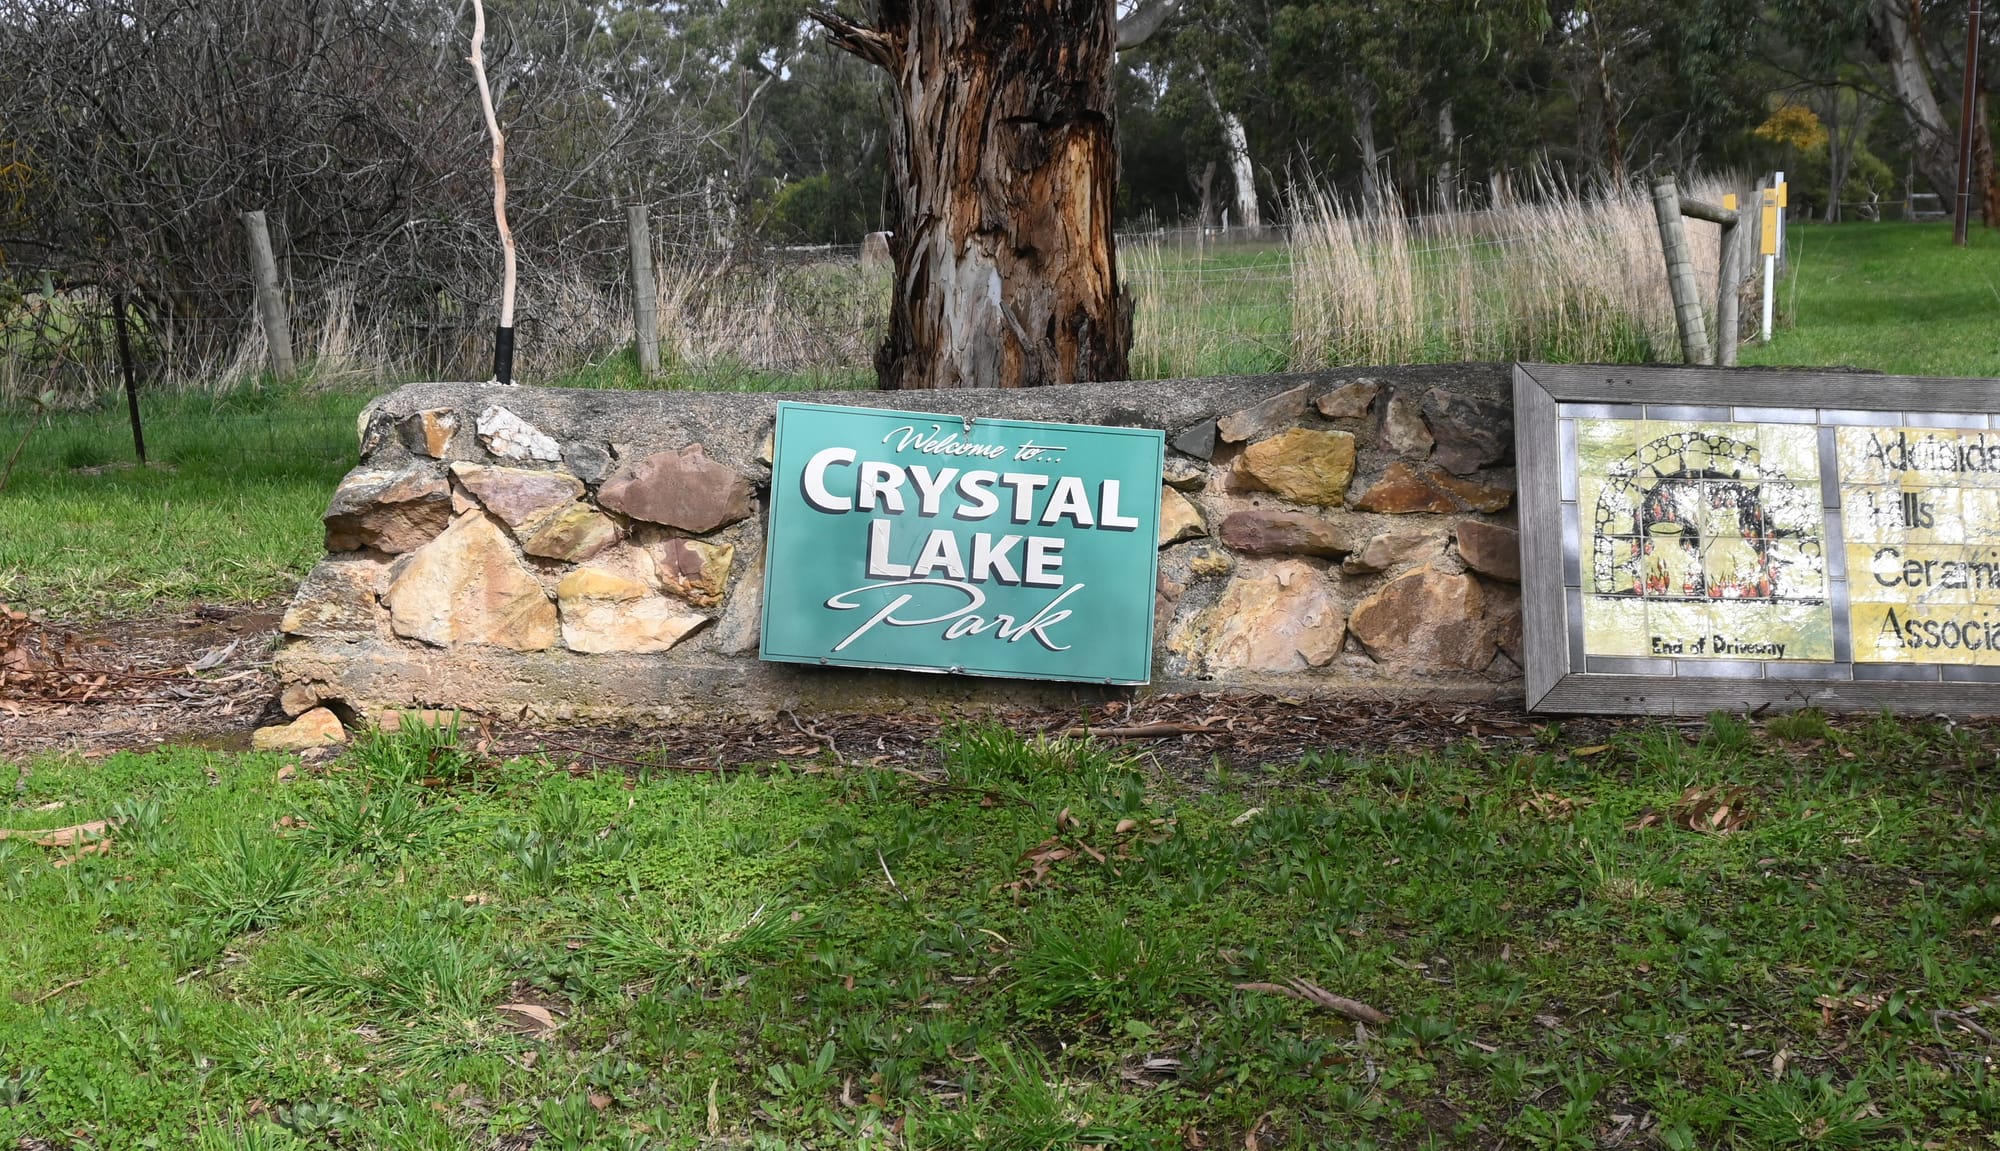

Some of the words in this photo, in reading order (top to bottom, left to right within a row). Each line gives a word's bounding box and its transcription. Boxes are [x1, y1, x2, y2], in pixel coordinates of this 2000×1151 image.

[882, 424, 1007, 460] Welcome
[801, 446, 1139, 532] CRYSTAL
[866, 518, 1065, 588] LAKE
[824, 577, 1086, 653] Park
[1651, 635, 1683, 655] End
[1690, 636, 1706, 655] of
[1713, 635, 1785, 660] Driveway
